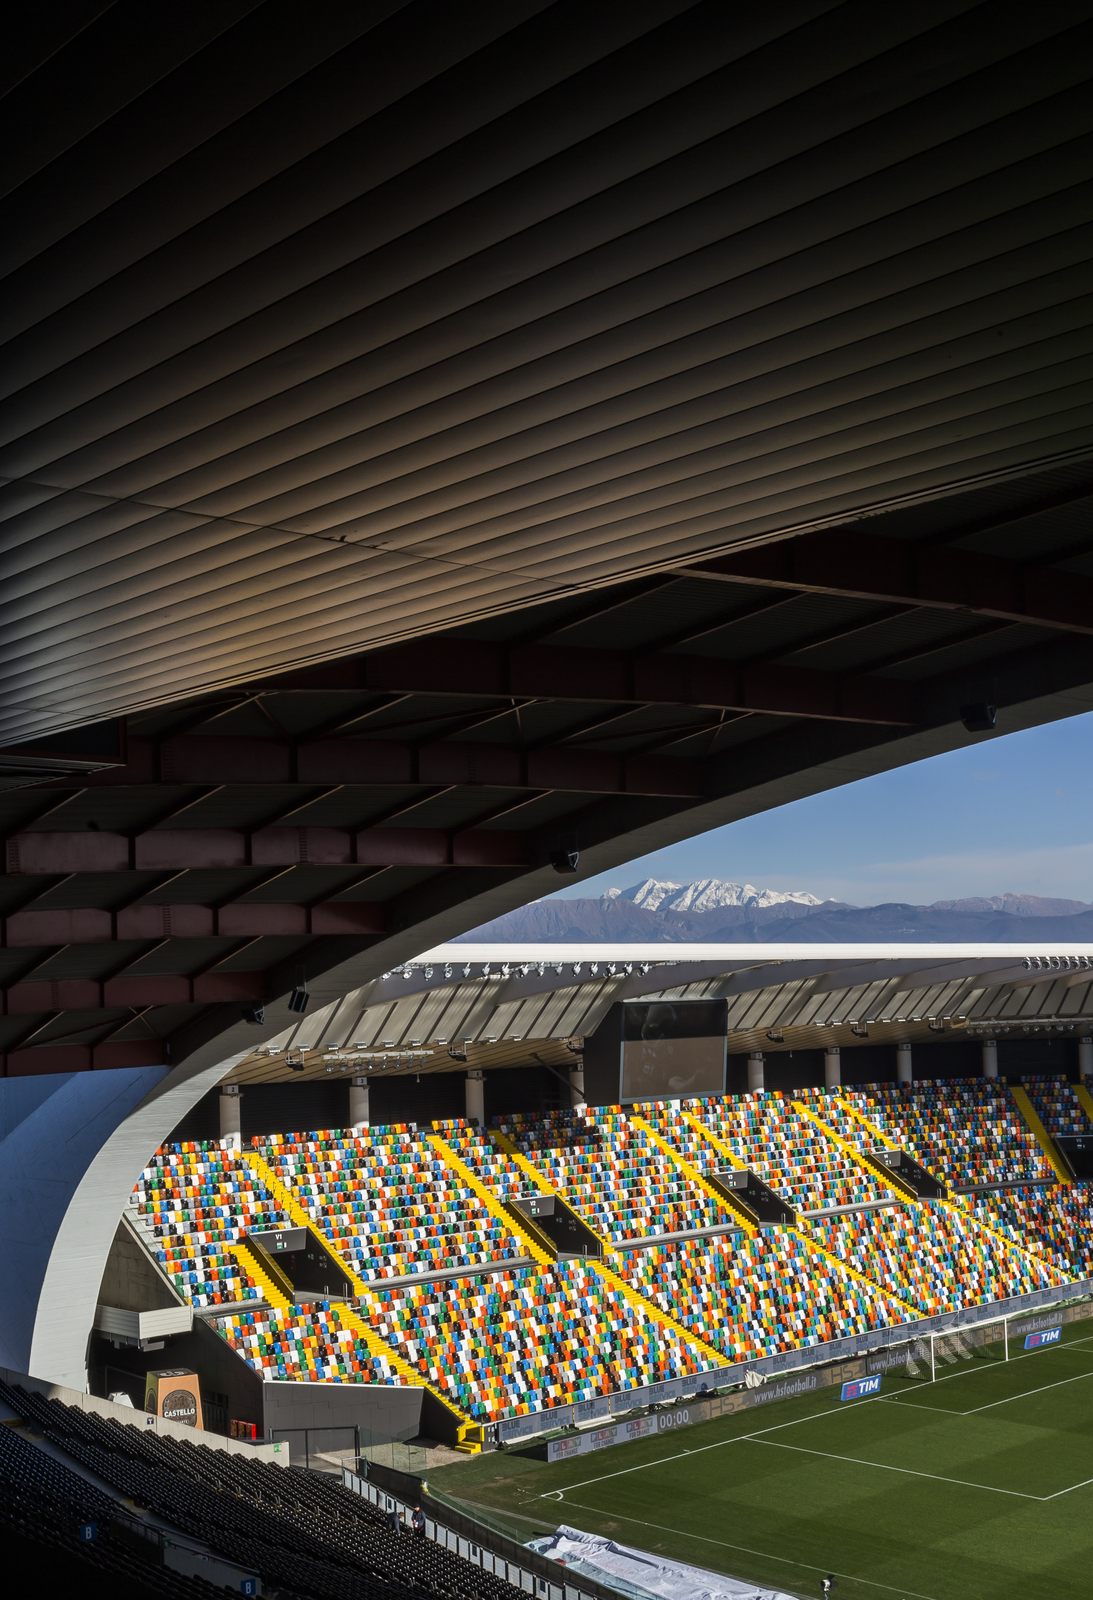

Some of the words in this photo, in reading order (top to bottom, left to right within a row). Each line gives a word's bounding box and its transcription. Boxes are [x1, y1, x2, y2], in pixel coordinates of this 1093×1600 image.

[1041, 1330, 1060, 1343] TIM
[754, 1376, 816, 1404] www.hsfootball.it
[859, 1378, 880, 1394] TIM
[164, 1408, 195, 1418] CASTELLO
[660, 1409, 689, 1429] 00:00
